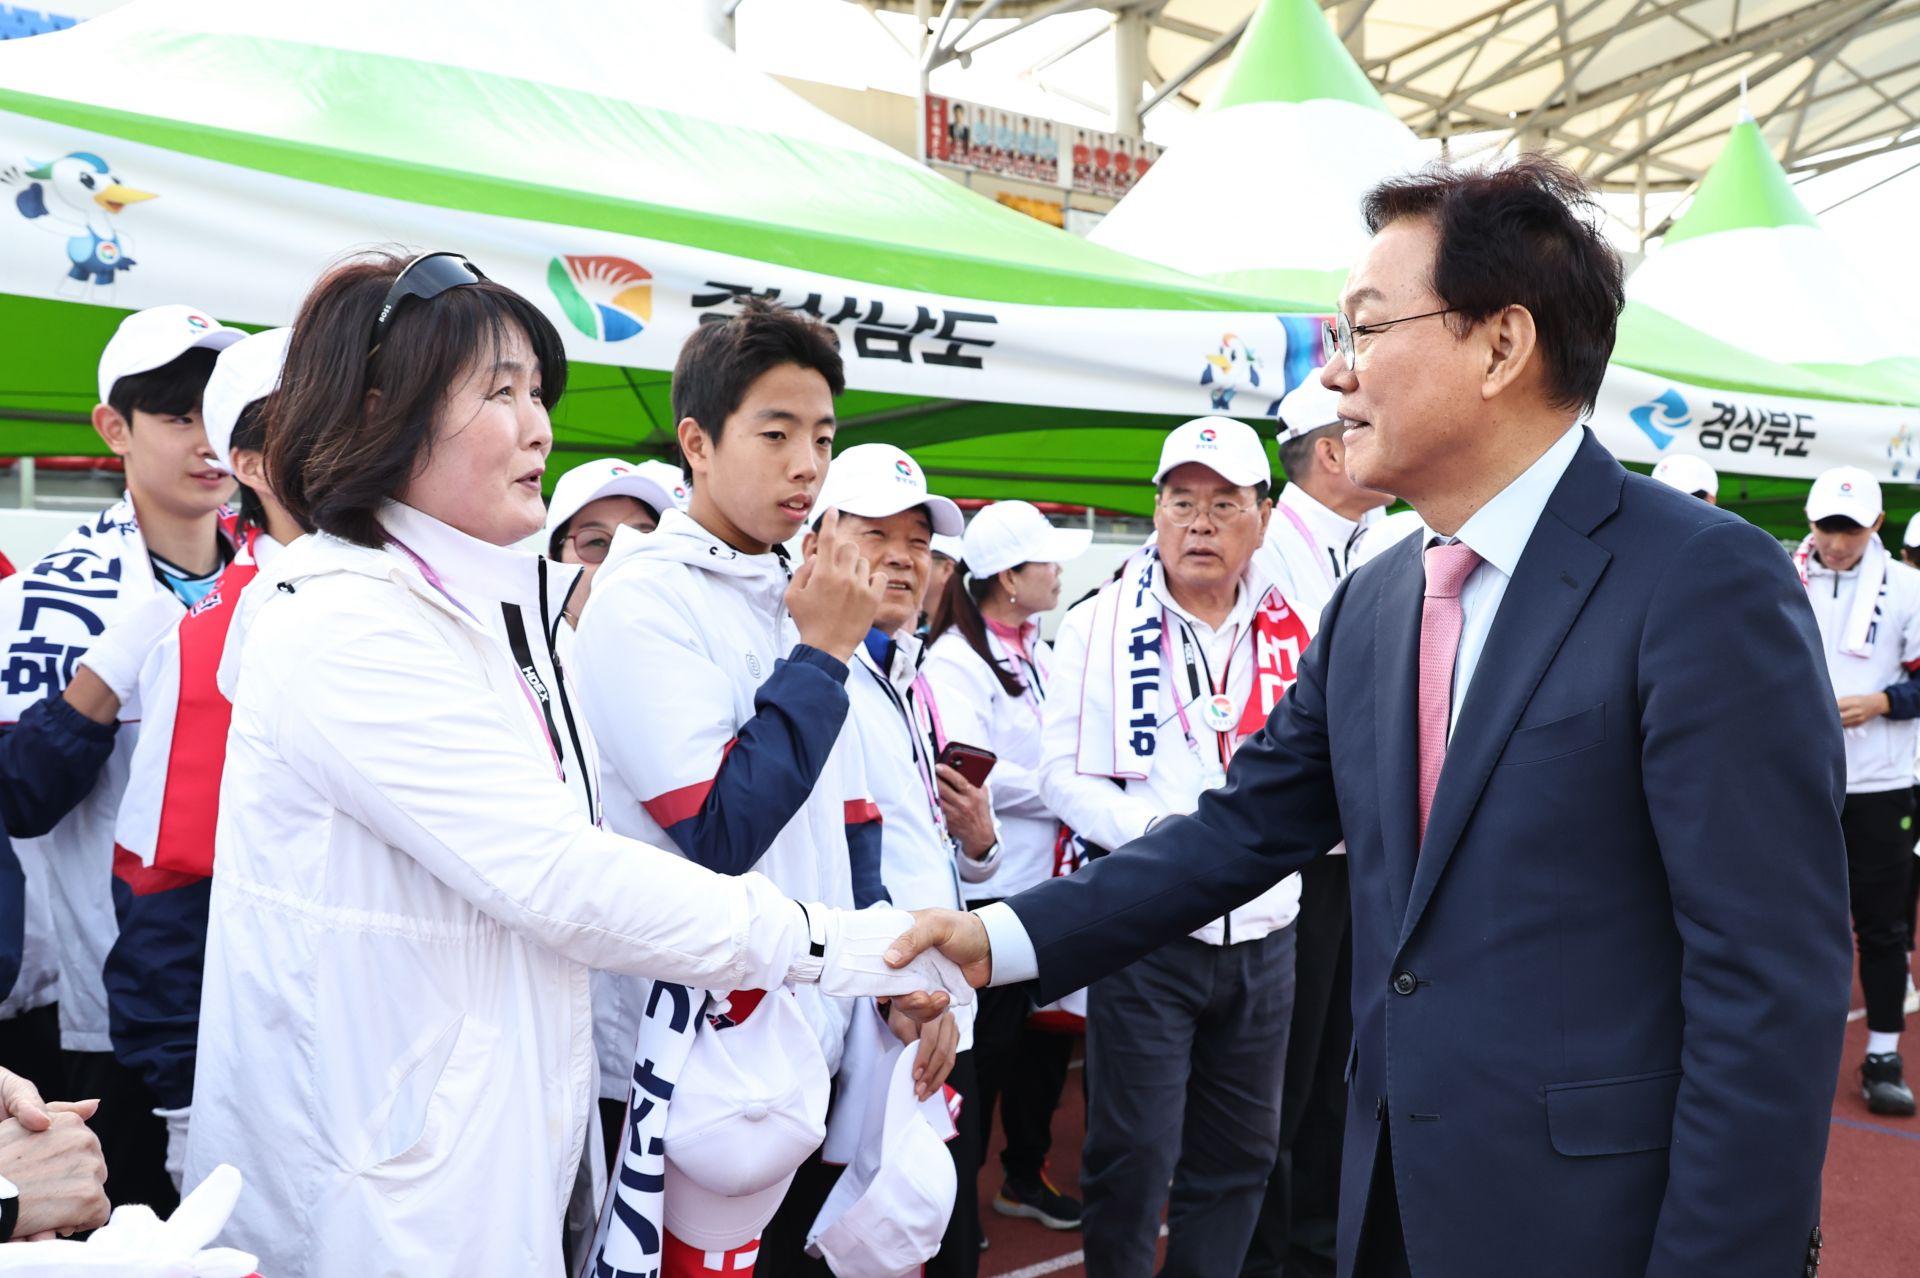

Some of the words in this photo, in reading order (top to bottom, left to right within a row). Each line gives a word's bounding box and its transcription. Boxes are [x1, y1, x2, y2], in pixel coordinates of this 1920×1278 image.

[379, 304, 391, 322] BOSS
[1699, 402, 1816, 457] 경상북도
[522, 666, 549, 702] HDEX
